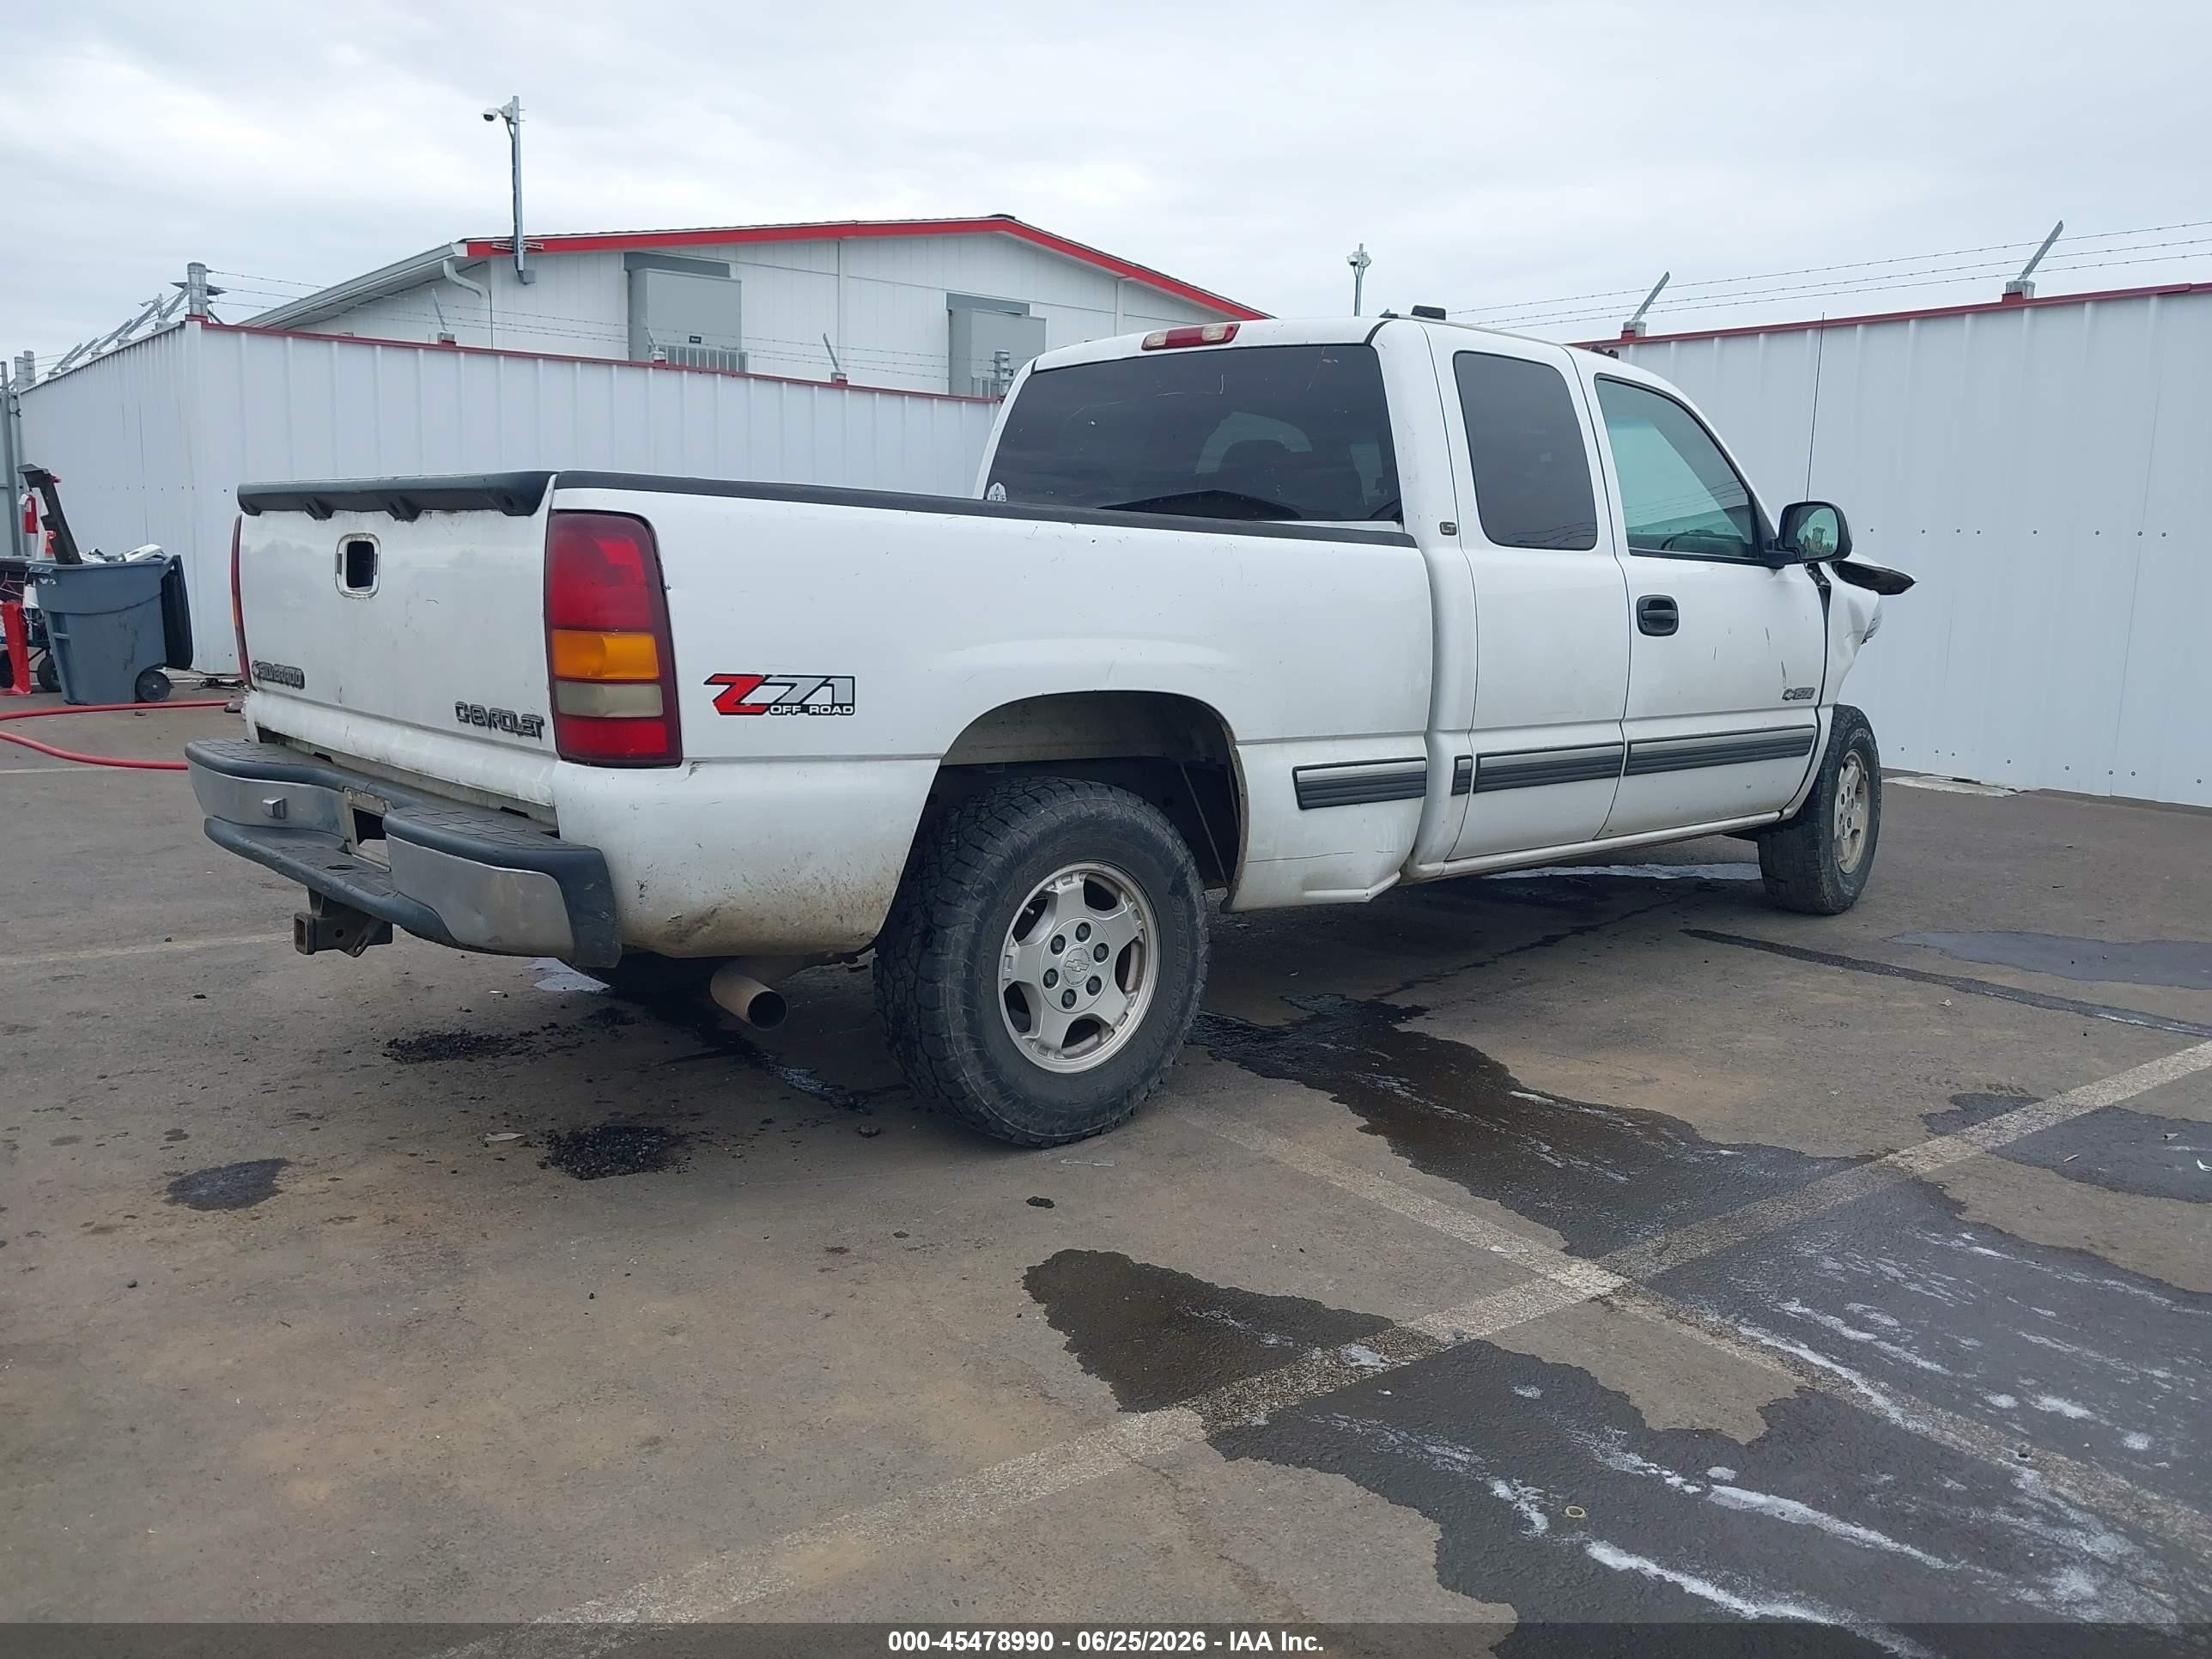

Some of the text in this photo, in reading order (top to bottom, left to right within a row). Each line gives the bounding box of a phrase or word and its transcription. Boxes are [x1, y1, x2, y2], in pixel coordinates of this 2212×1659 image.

[1440, 522, 1457, 536] LT
[258, 663, 304, 688] SILVERADO
[703, 673, 855, 716] Z71
[454, 701, 545, 741] CHEVROLET
[769, 705, 854, 715] OFF ROAD
